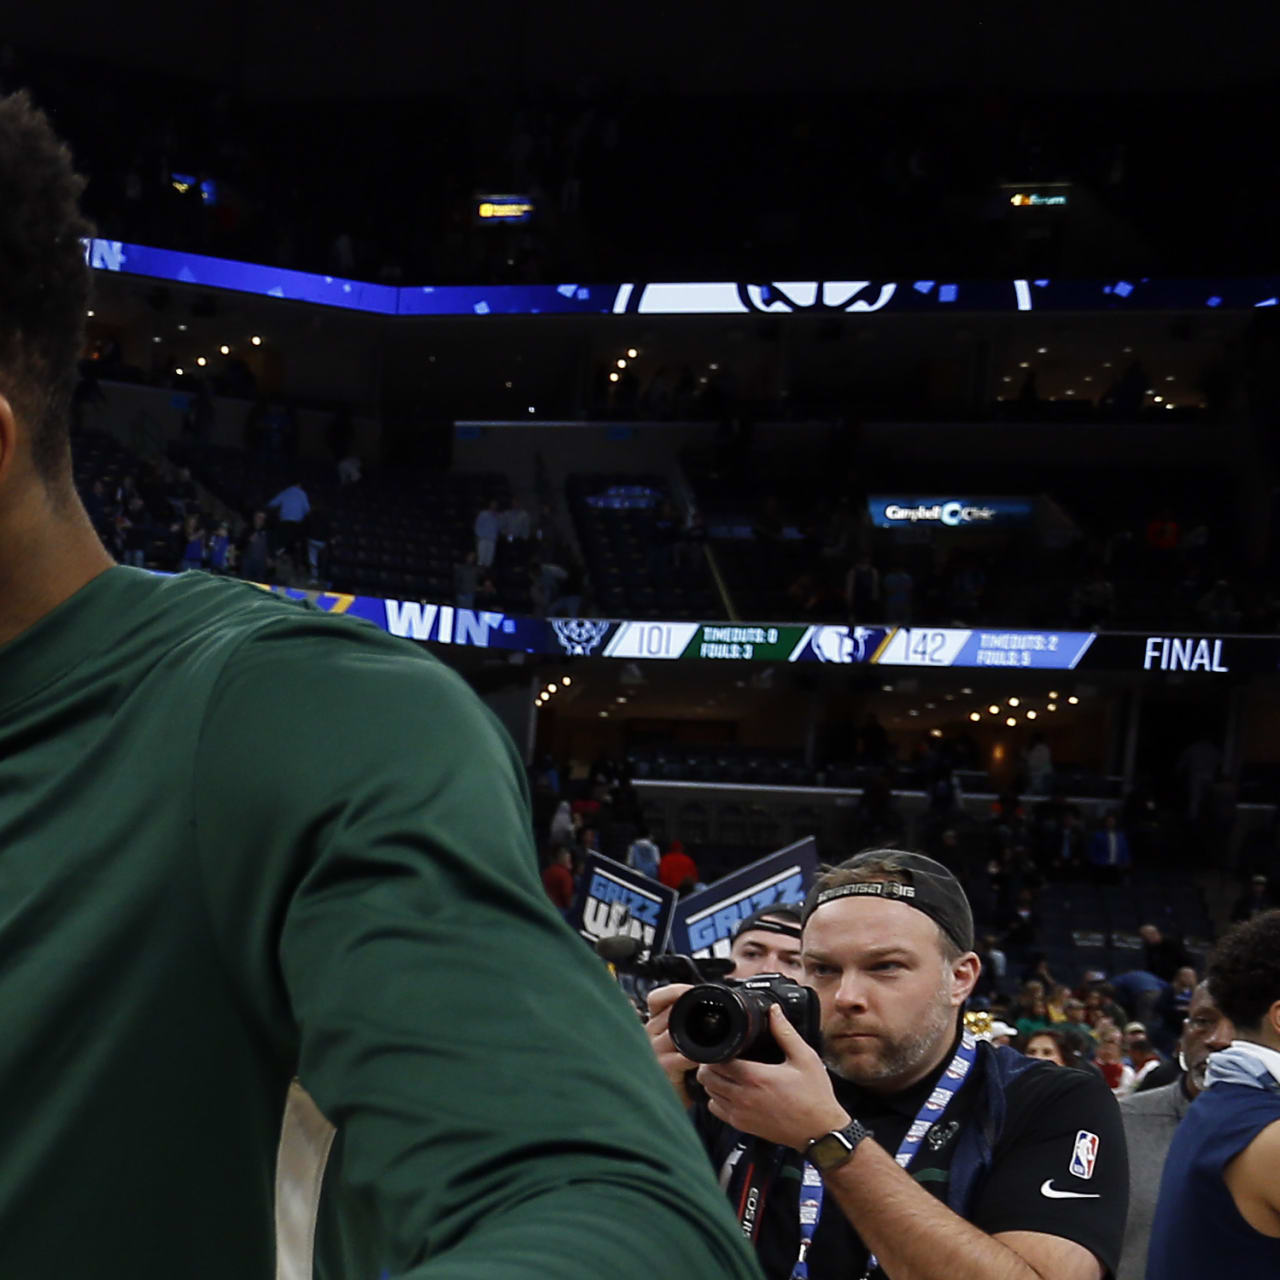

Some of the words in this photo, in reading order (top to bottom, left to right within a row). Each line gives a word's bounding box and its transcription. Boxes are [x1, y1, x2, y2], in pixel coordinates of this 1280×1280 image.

[384, 599, 490, 648] WIN
[703, 626, 766, 643] TIMEOUTS:
[639, 626, 672, 658] 101
[700, 643, 741, 658] FOULS:
[903, 630, 947, 663] 142
[1143, 636, 1229, 673] FINAL
[590, 873, 663, 927] GRIZZ
